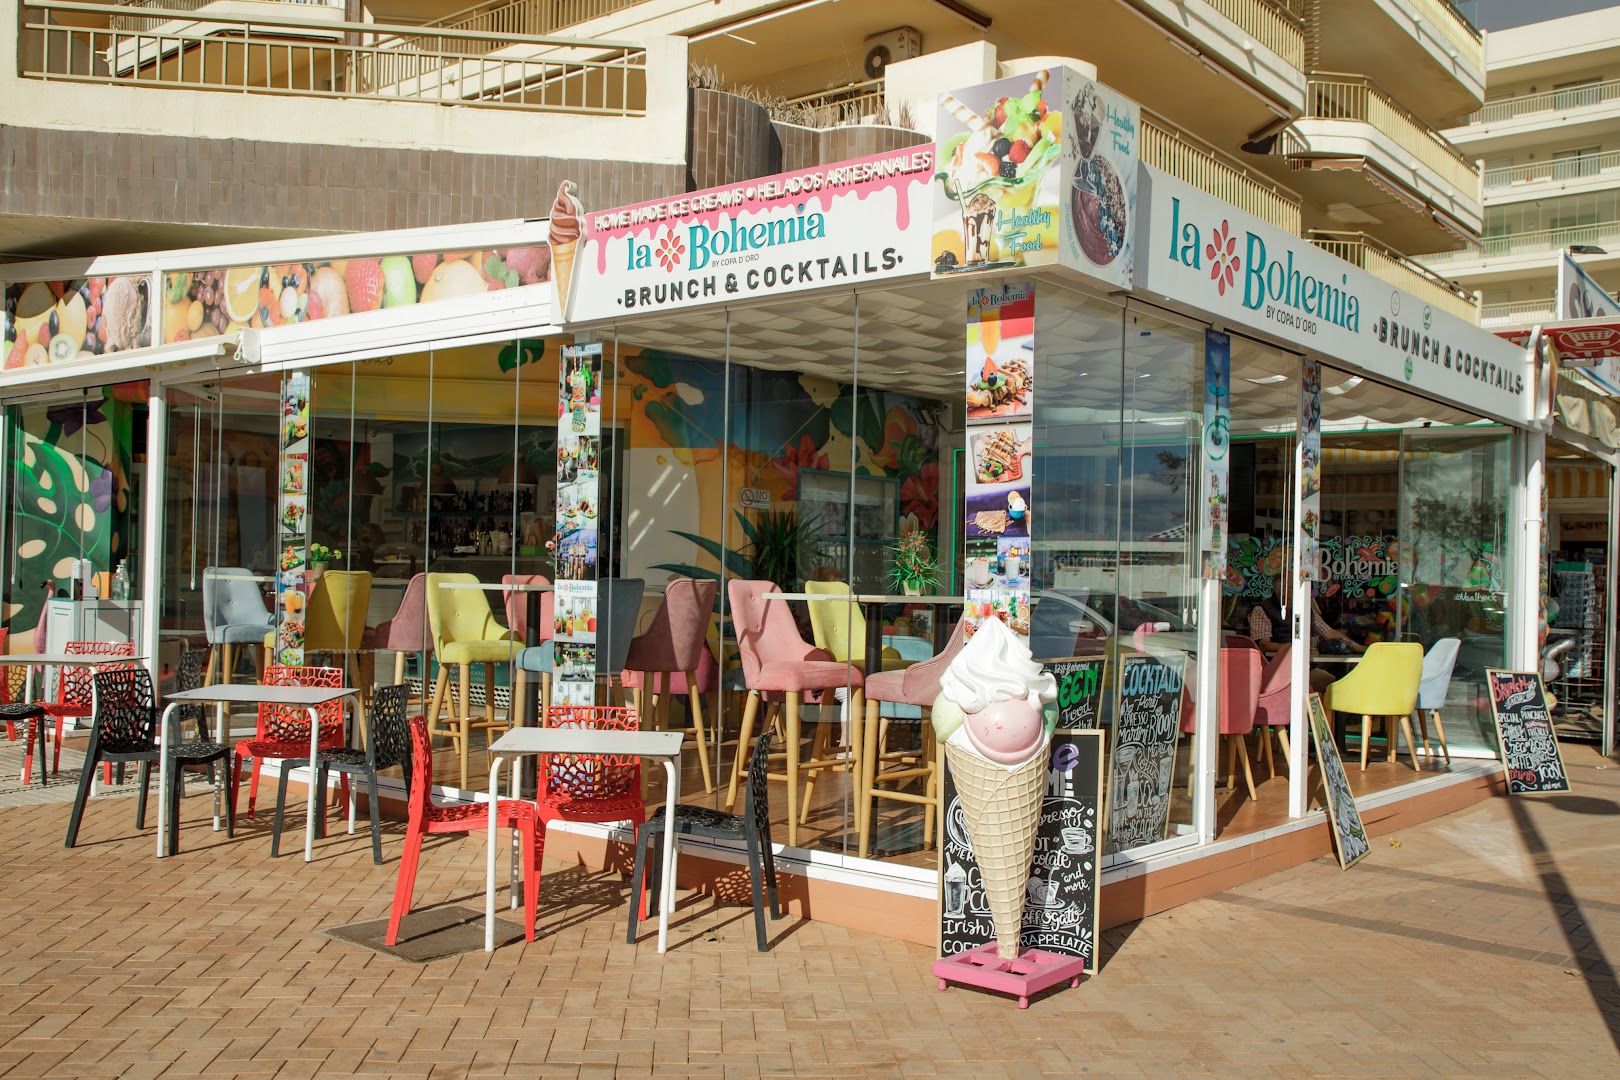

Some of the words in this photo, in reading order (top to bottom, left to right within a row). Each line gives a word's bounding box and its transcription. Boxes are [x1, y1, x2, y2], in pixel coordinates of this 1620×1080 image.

[1105, 104, 1135, 139] Healthy
[1110, 129, 1131, 156] Food
[595, 210, 630, 231] HOME
[631, 203, 667, 225] MADE
[667, 198, 690, 219] ICE
[691, 188, 743, 212] CREAMS
[757, 172, 824, 201] HELADOS
[825, 151, 932, 189] ARTESANALES
[997, 207, 1051, 231] Healthy
[627, 237, 652, 271] la
[688, 203, 826, 271] Bohemia
[1003, 231, 1043, 256] Food
[721, 257, 737, 266] COPA
[1168, 197, 1202, 271] la
[1241, 230, 1360, 334] Bohemia
[624, 275, 716, 309] BRUNCH
[724, 272, 739, 294] &
[746, 247, 897, 290] COCKTAILS
[990, 290, 1028, 306] Bohemia
[1266, 305, 1276, 320] BY
[1276, 309, 1294, 327] COPA
[1379, 315, 1440, 365] BRUNCH
[1443, 344, 1452, 369] &
[1455, 349, 1522, 396] COCKTAILS
[755, 490, 768, 500] NO
[1318, 547, 1398, 581] Bohemia
[1122, 664, 1183, 696] COCKTAILS
[1061, 693, 1092, 724] Food
[1063, 862, 1085, 883] and
[1063, 878, 1088, 893] more
[942, 919, 989, 936] Irish
